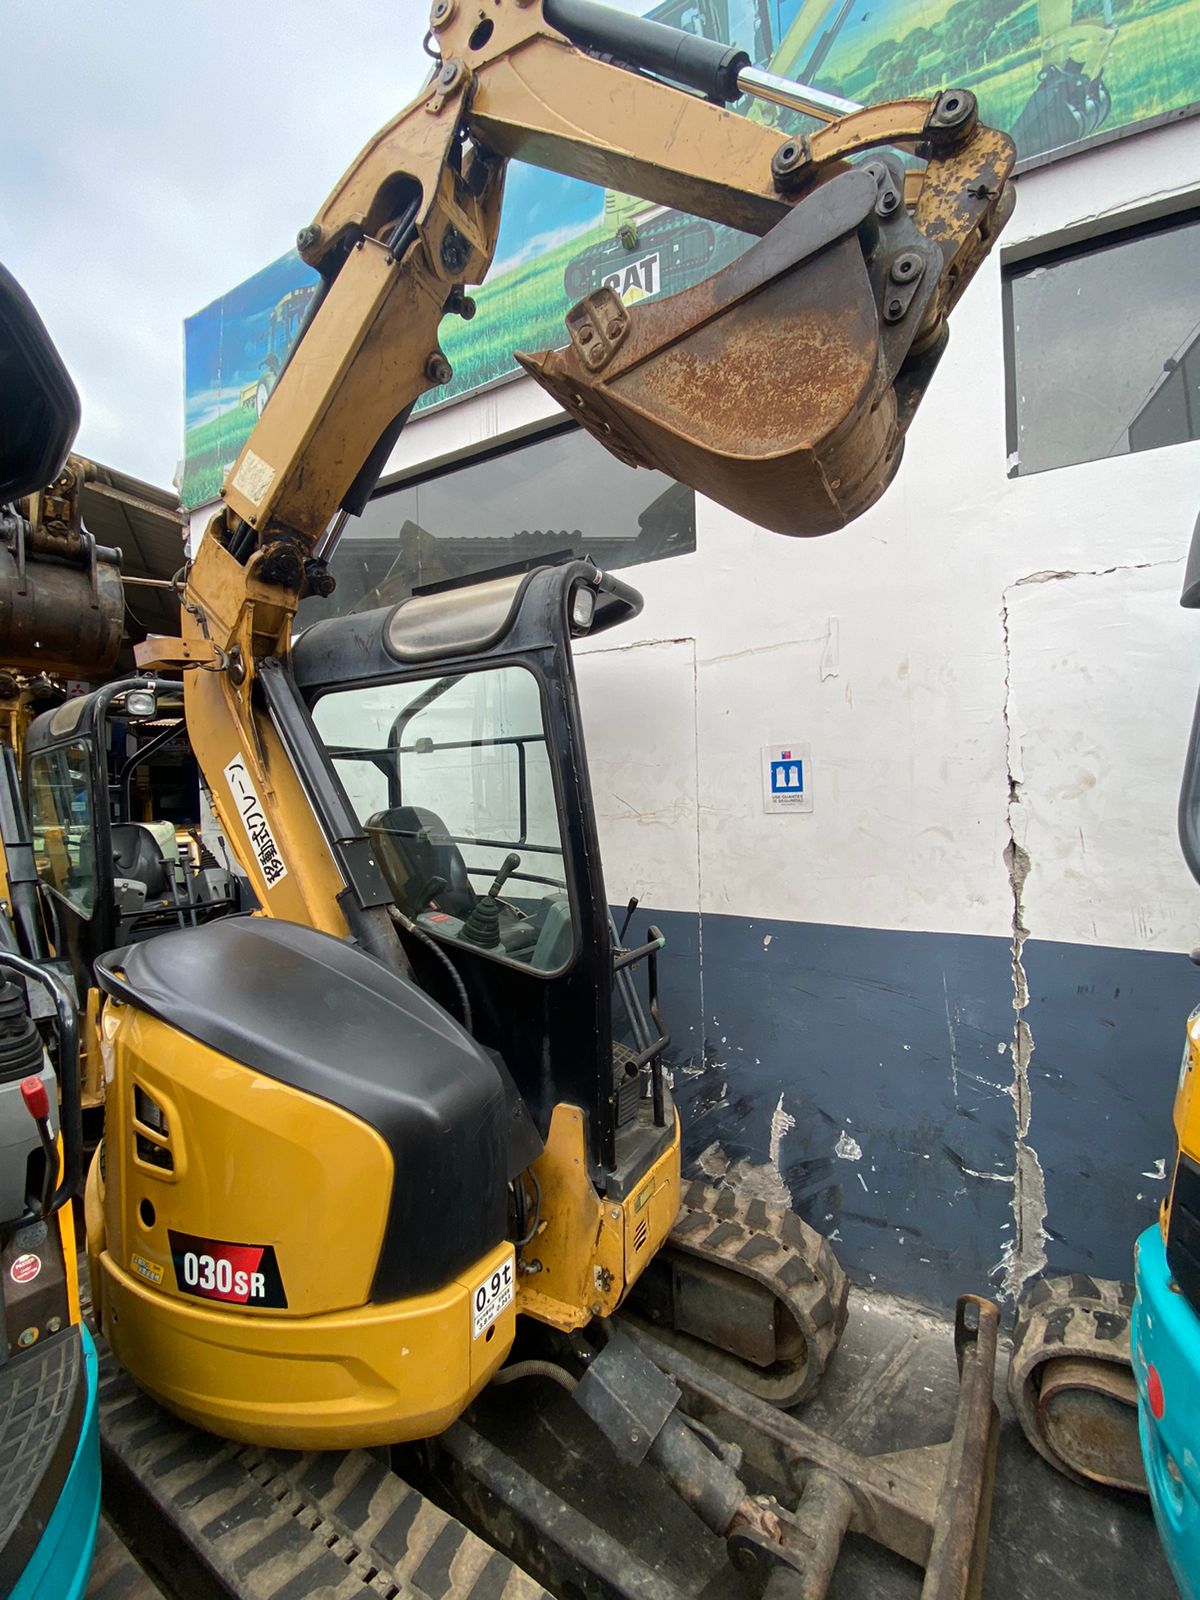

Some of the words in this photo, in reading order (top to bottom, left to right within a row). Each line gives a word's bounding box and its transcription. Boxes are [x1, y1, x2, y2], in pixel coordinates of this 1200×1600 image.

[228, 764, 284, 884] 移動式クレーン
[184, 1252, 265, 1297] 030SR
